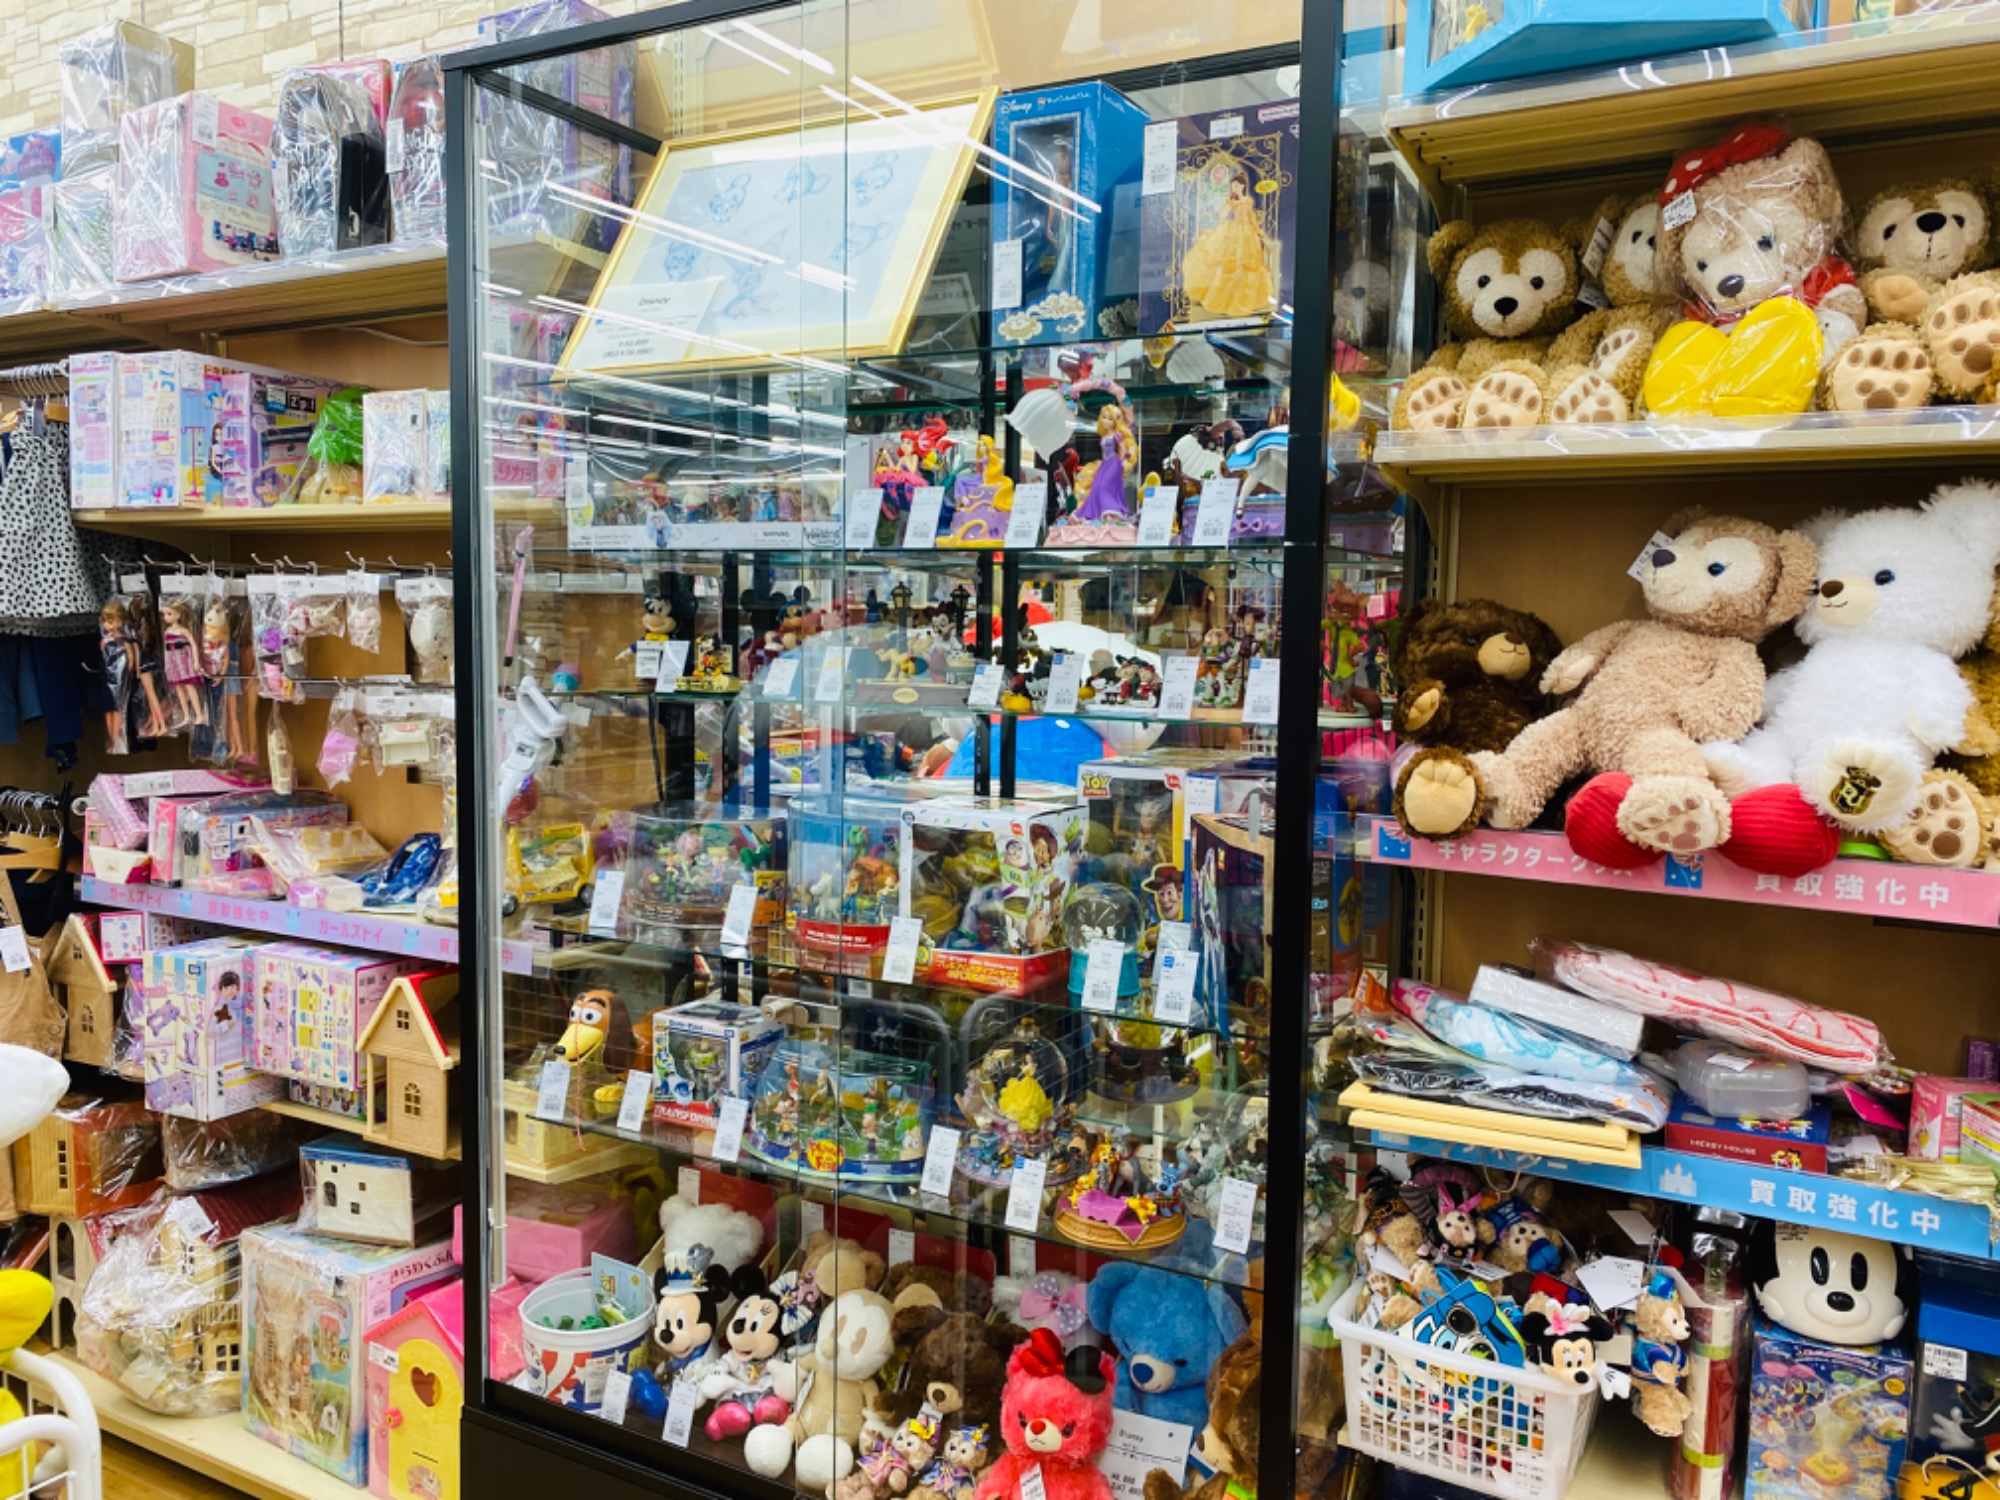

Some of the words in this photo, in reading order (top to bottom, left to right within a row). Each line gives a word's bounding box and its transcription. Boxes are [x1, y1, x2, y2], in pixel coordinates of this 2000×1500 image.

[1082, 775, 1111, 788] TOY
[1749, 1179, 1941, 1235] 買取強化中
